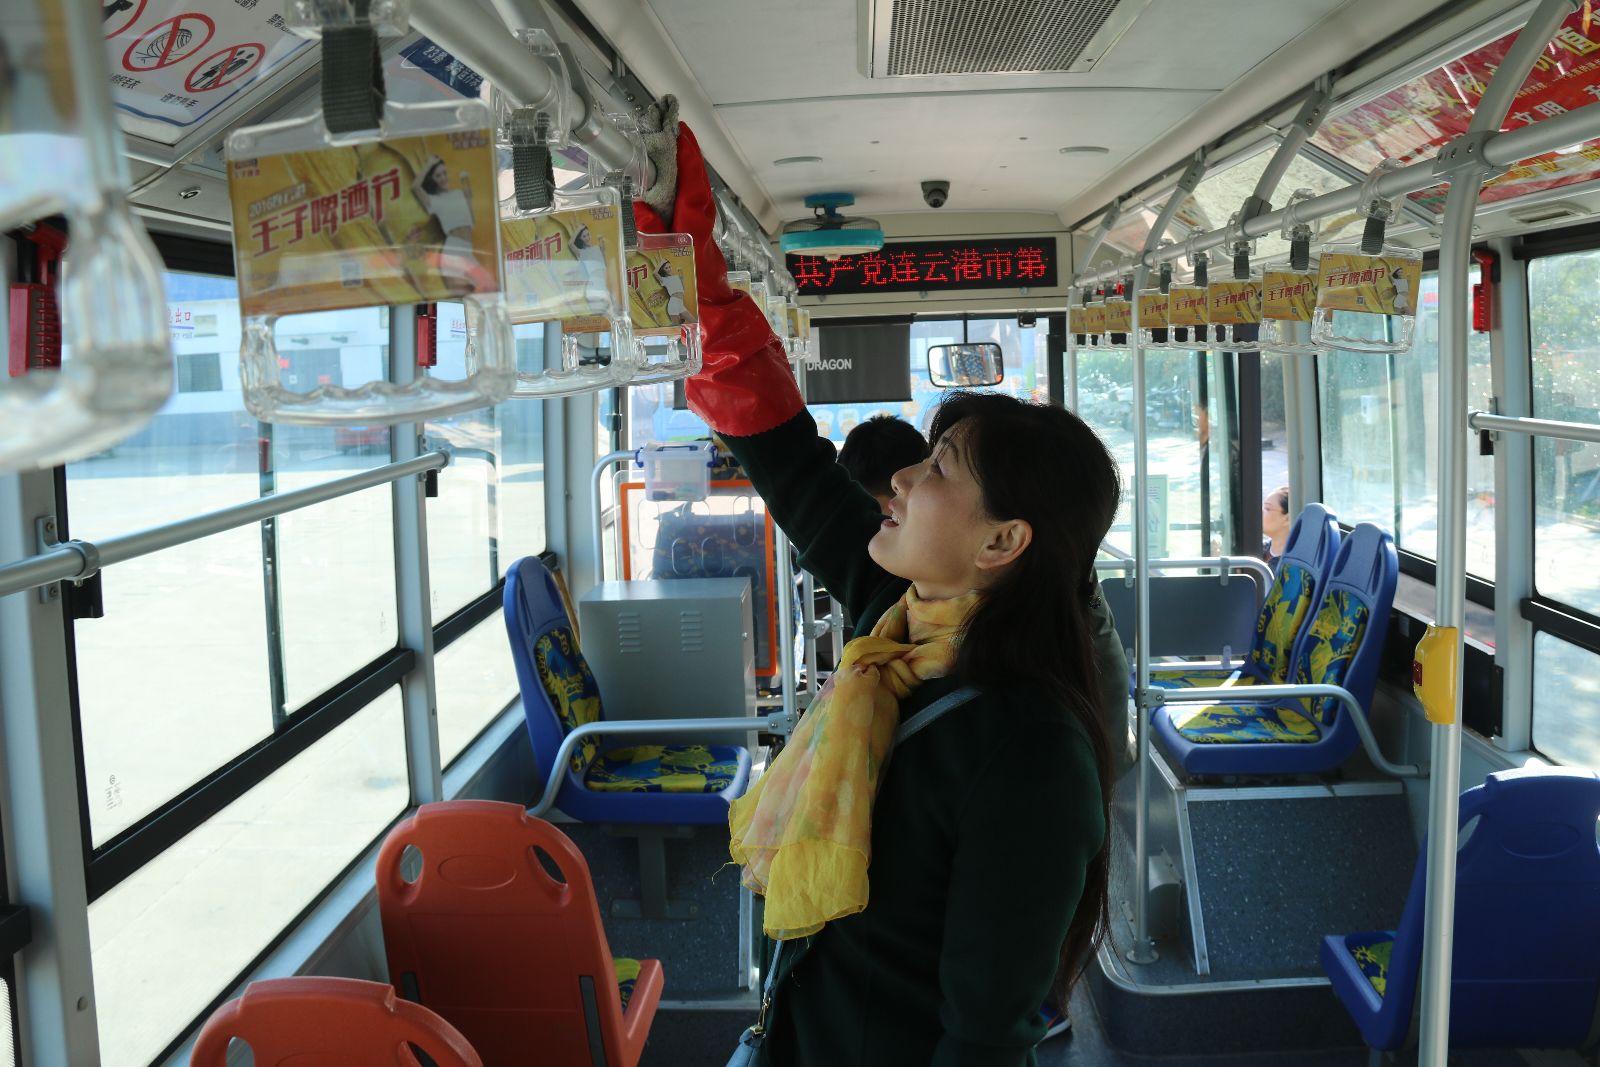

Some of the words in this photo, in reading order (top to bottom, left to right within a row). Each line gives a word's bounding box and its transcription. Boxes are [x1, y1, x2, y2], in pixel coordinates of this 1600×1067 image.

[251, 167, 400, 258] 王子啤酒节
[795, 246, 1049, 288] 共产党连云港市第
[806, 358, 852, 371] DRAGON
